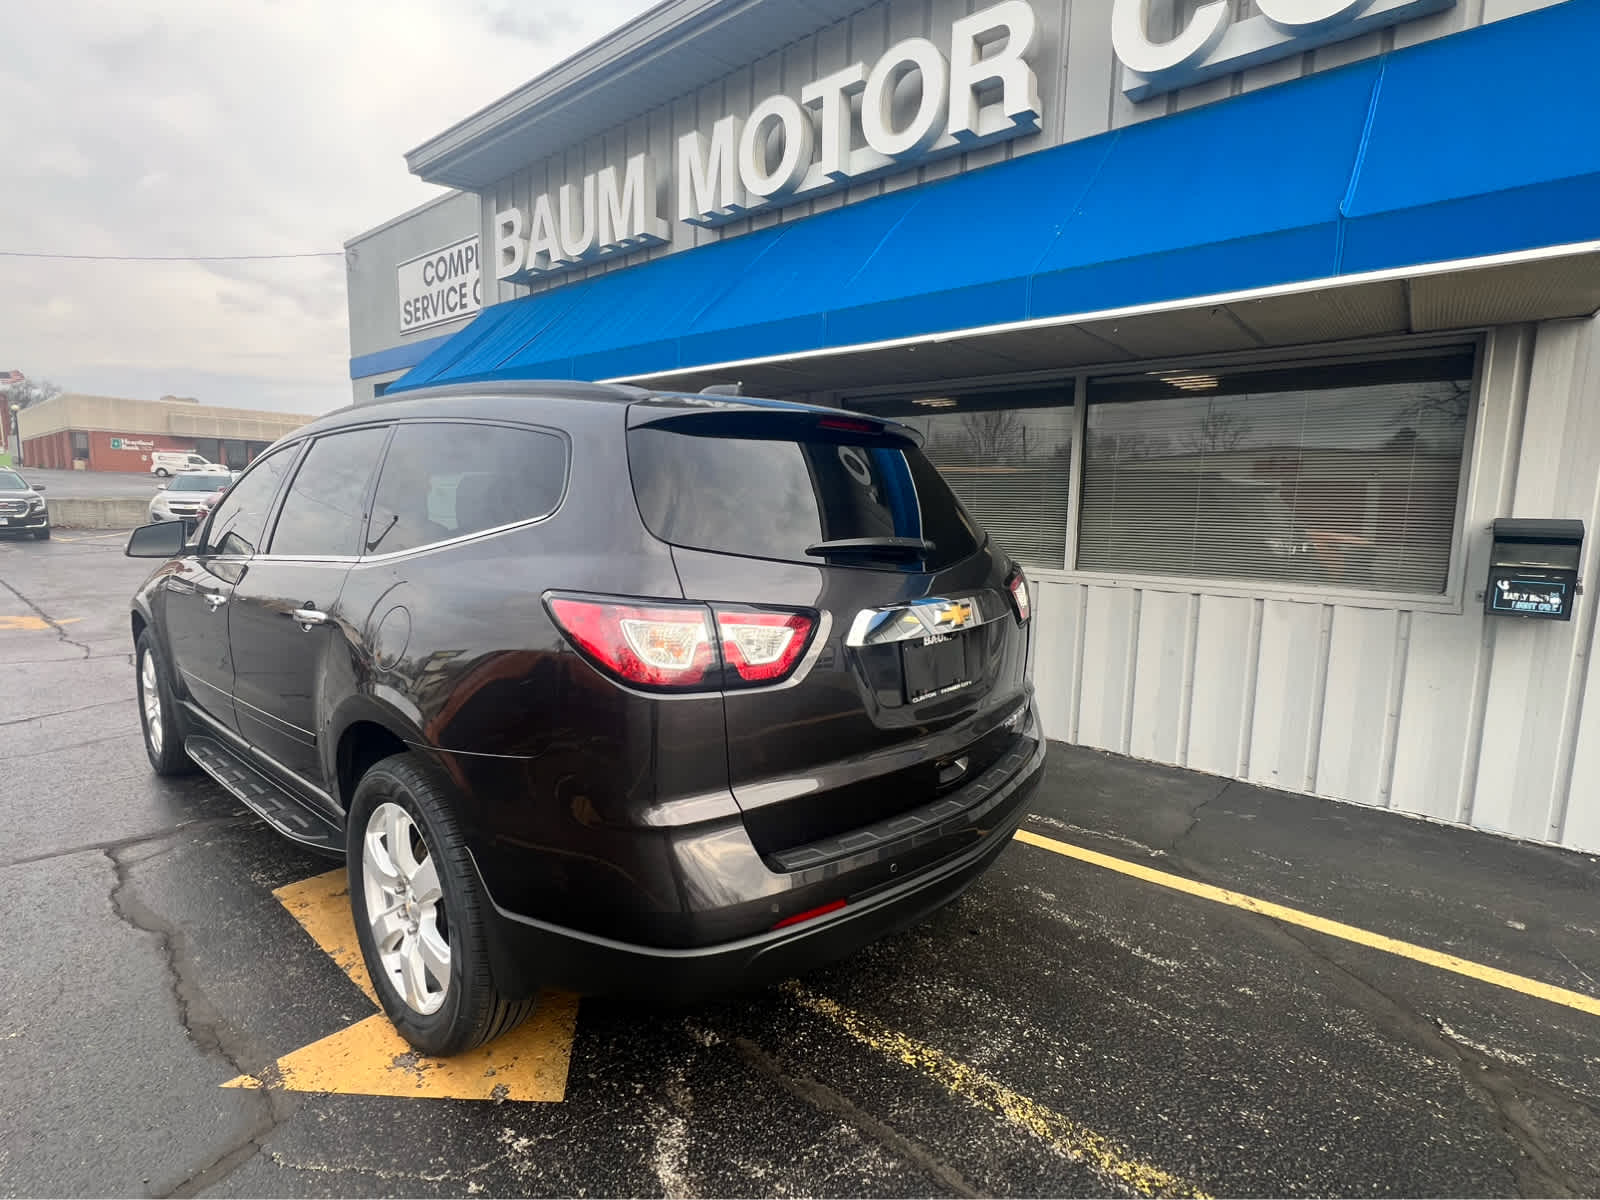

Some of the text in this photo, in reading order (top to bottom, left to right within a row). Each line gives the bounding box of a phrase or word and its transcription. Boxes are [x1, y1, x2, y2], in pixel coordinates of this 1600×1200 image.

[494, 153, 656, 279] BAUM
[678, 0, 1040, 221] MOTOR
[403, 282, 468, 325] SERVICE
